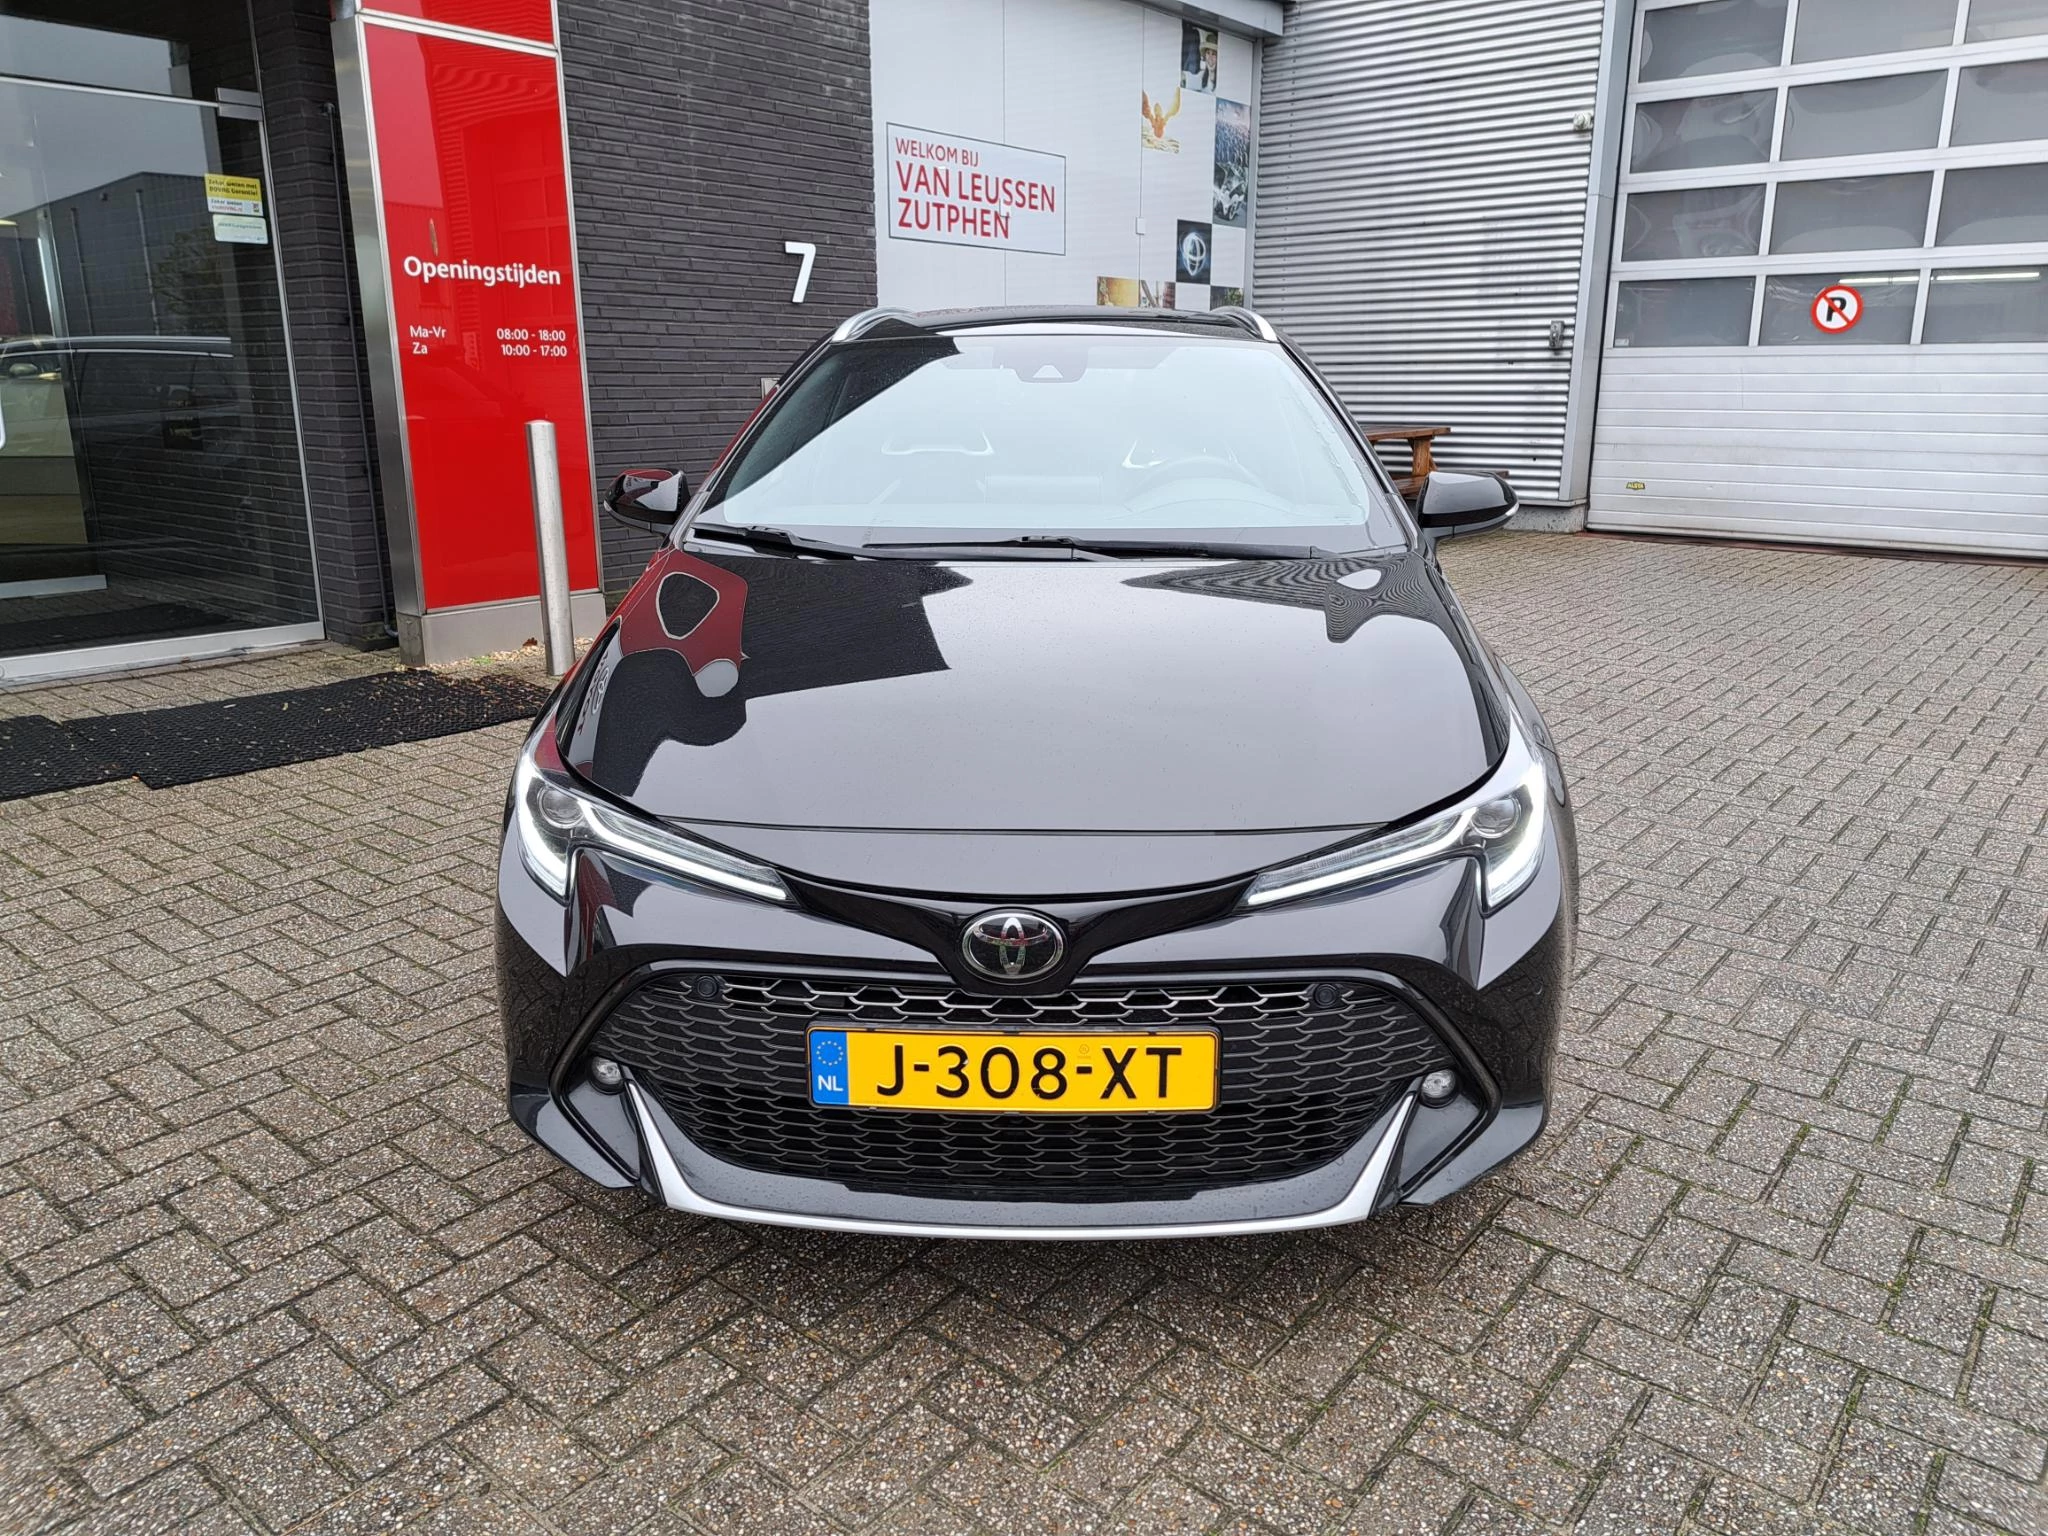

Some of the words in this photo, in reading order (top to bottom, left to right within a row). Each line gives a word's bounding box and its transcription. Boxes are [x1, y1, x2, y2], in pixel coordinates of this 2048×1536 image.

[895, 137, 958, 164] WELKOM
[961, 149, 979, 167] BIJ
[896, 160, 950, 198] VAN
[958, 171, 1056, 213] LEUSSEN
[897, 197, 1010, 239] ZUTPHEN
[403, 255, 561, 288] Openingstijden
[785, 241, 817, 303] 7
[409, 324, 447, 339] Ma-Vr
[496, 327, 529, 341] 08:00
[539, 329, 566, 342] 18:00
[412, 341, 428, 355] Za
[501, 343, 531, 356] 10:00
[540, 344, 568, 357] 17:00
[817, 1075, 844, 1092] NL
[876, 1044, 1182, 1100] J-308-XT
